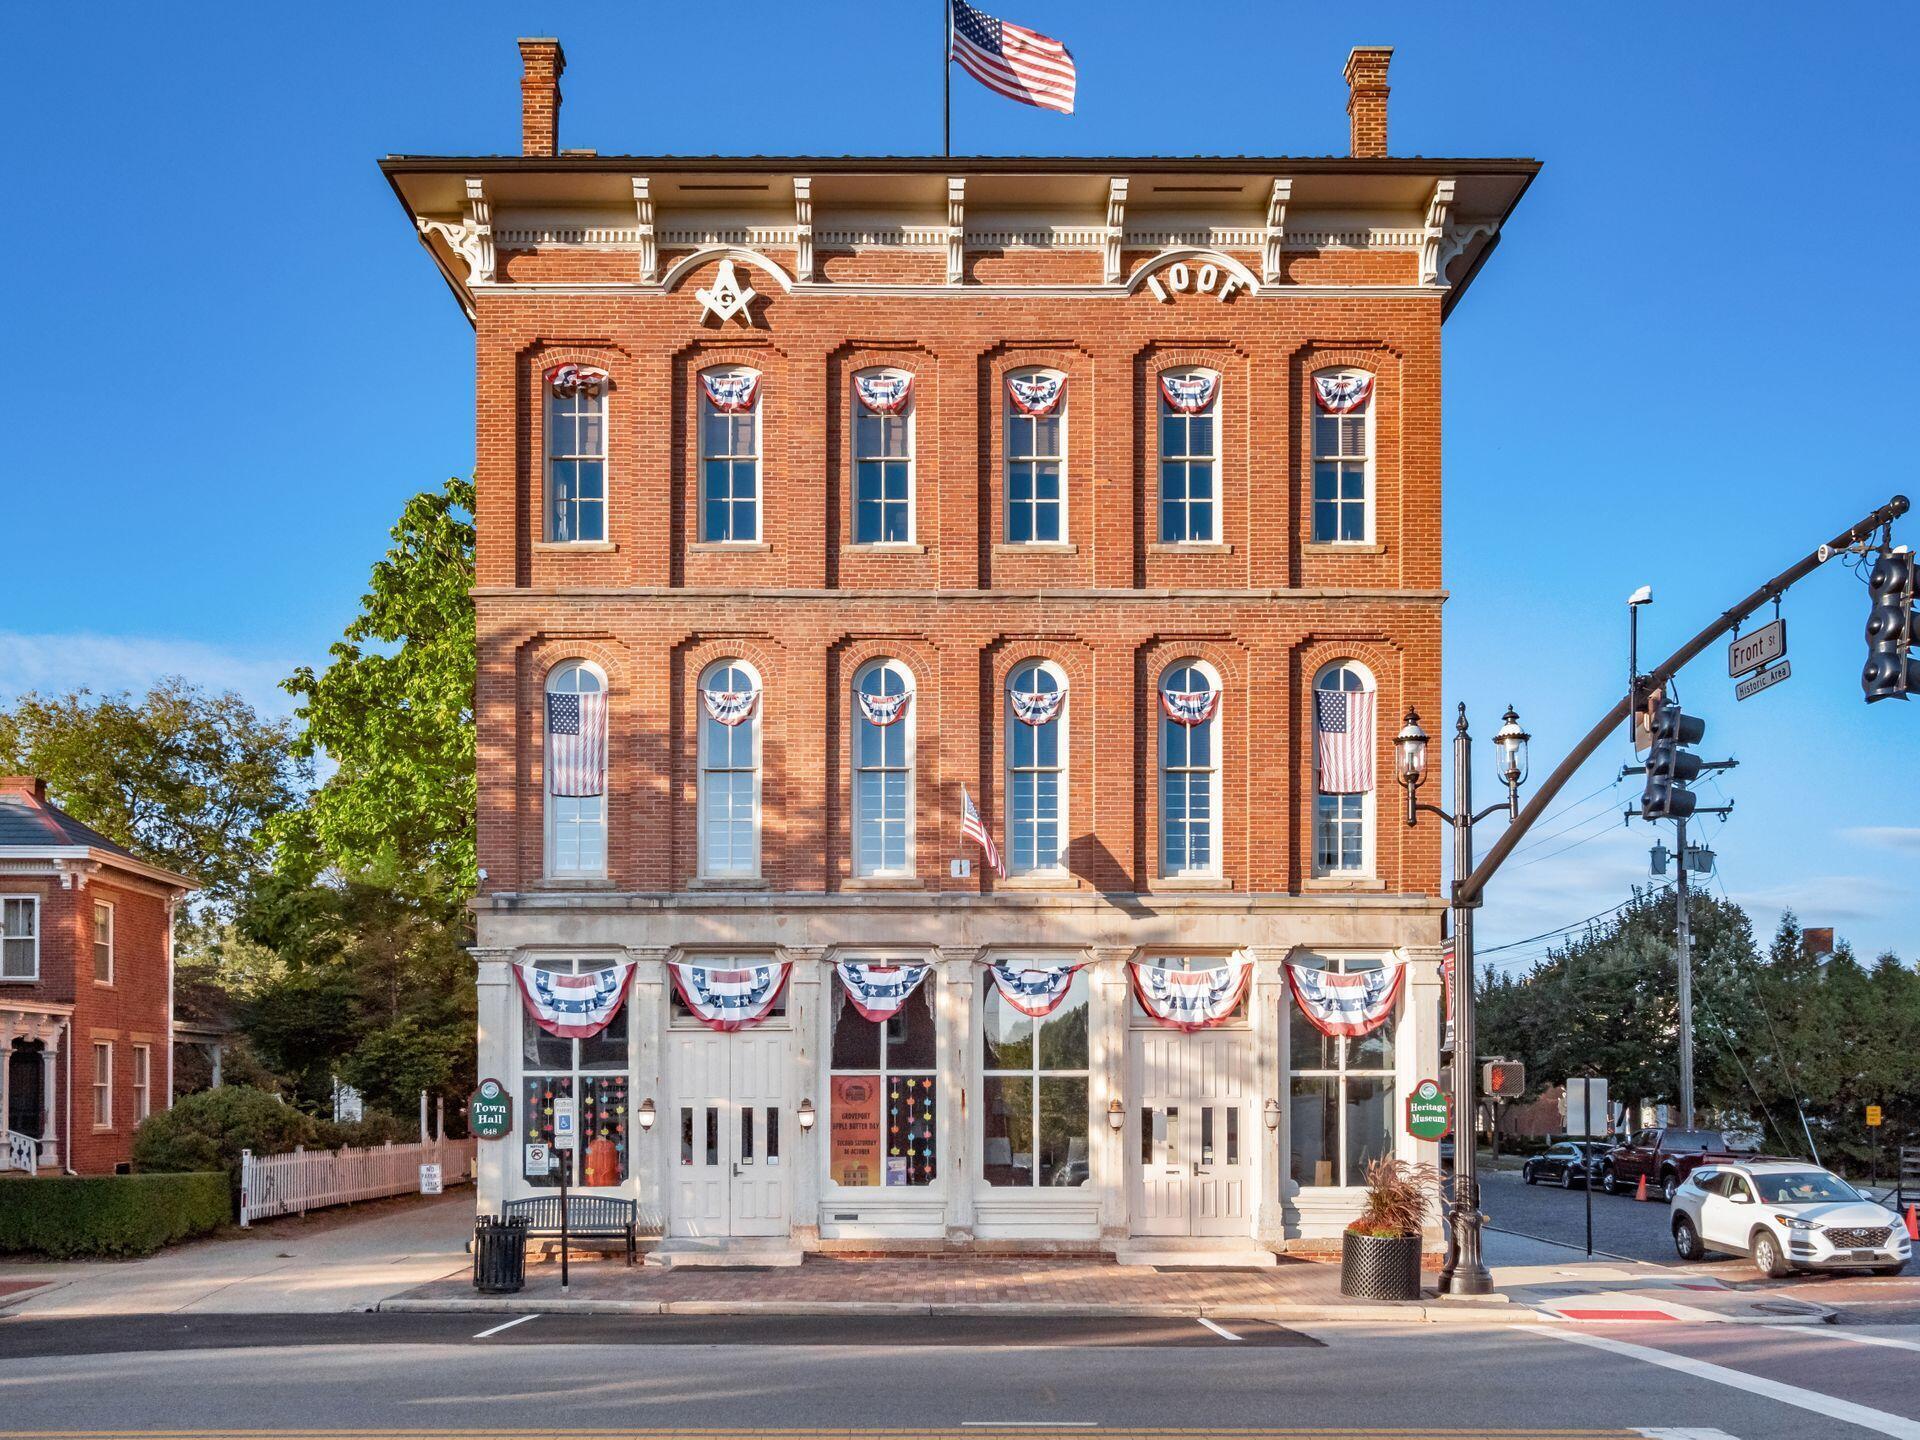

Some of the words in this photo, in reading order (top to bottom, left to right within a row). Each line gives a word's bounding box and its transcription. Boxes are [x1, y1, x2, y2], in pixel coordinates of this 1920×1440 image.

[1733, 637, 1764, 668] Front
[1739, 676, 1767, 697] Historic
[1770, 667, 1787, 682] Area
[474, 1102, 506, 1114] Town
[1410, 1102, 1447, 1113] Heritage
[478, 1114, 502, 1124] Hall
[1412, 1114, 1446, 1124] Museum
